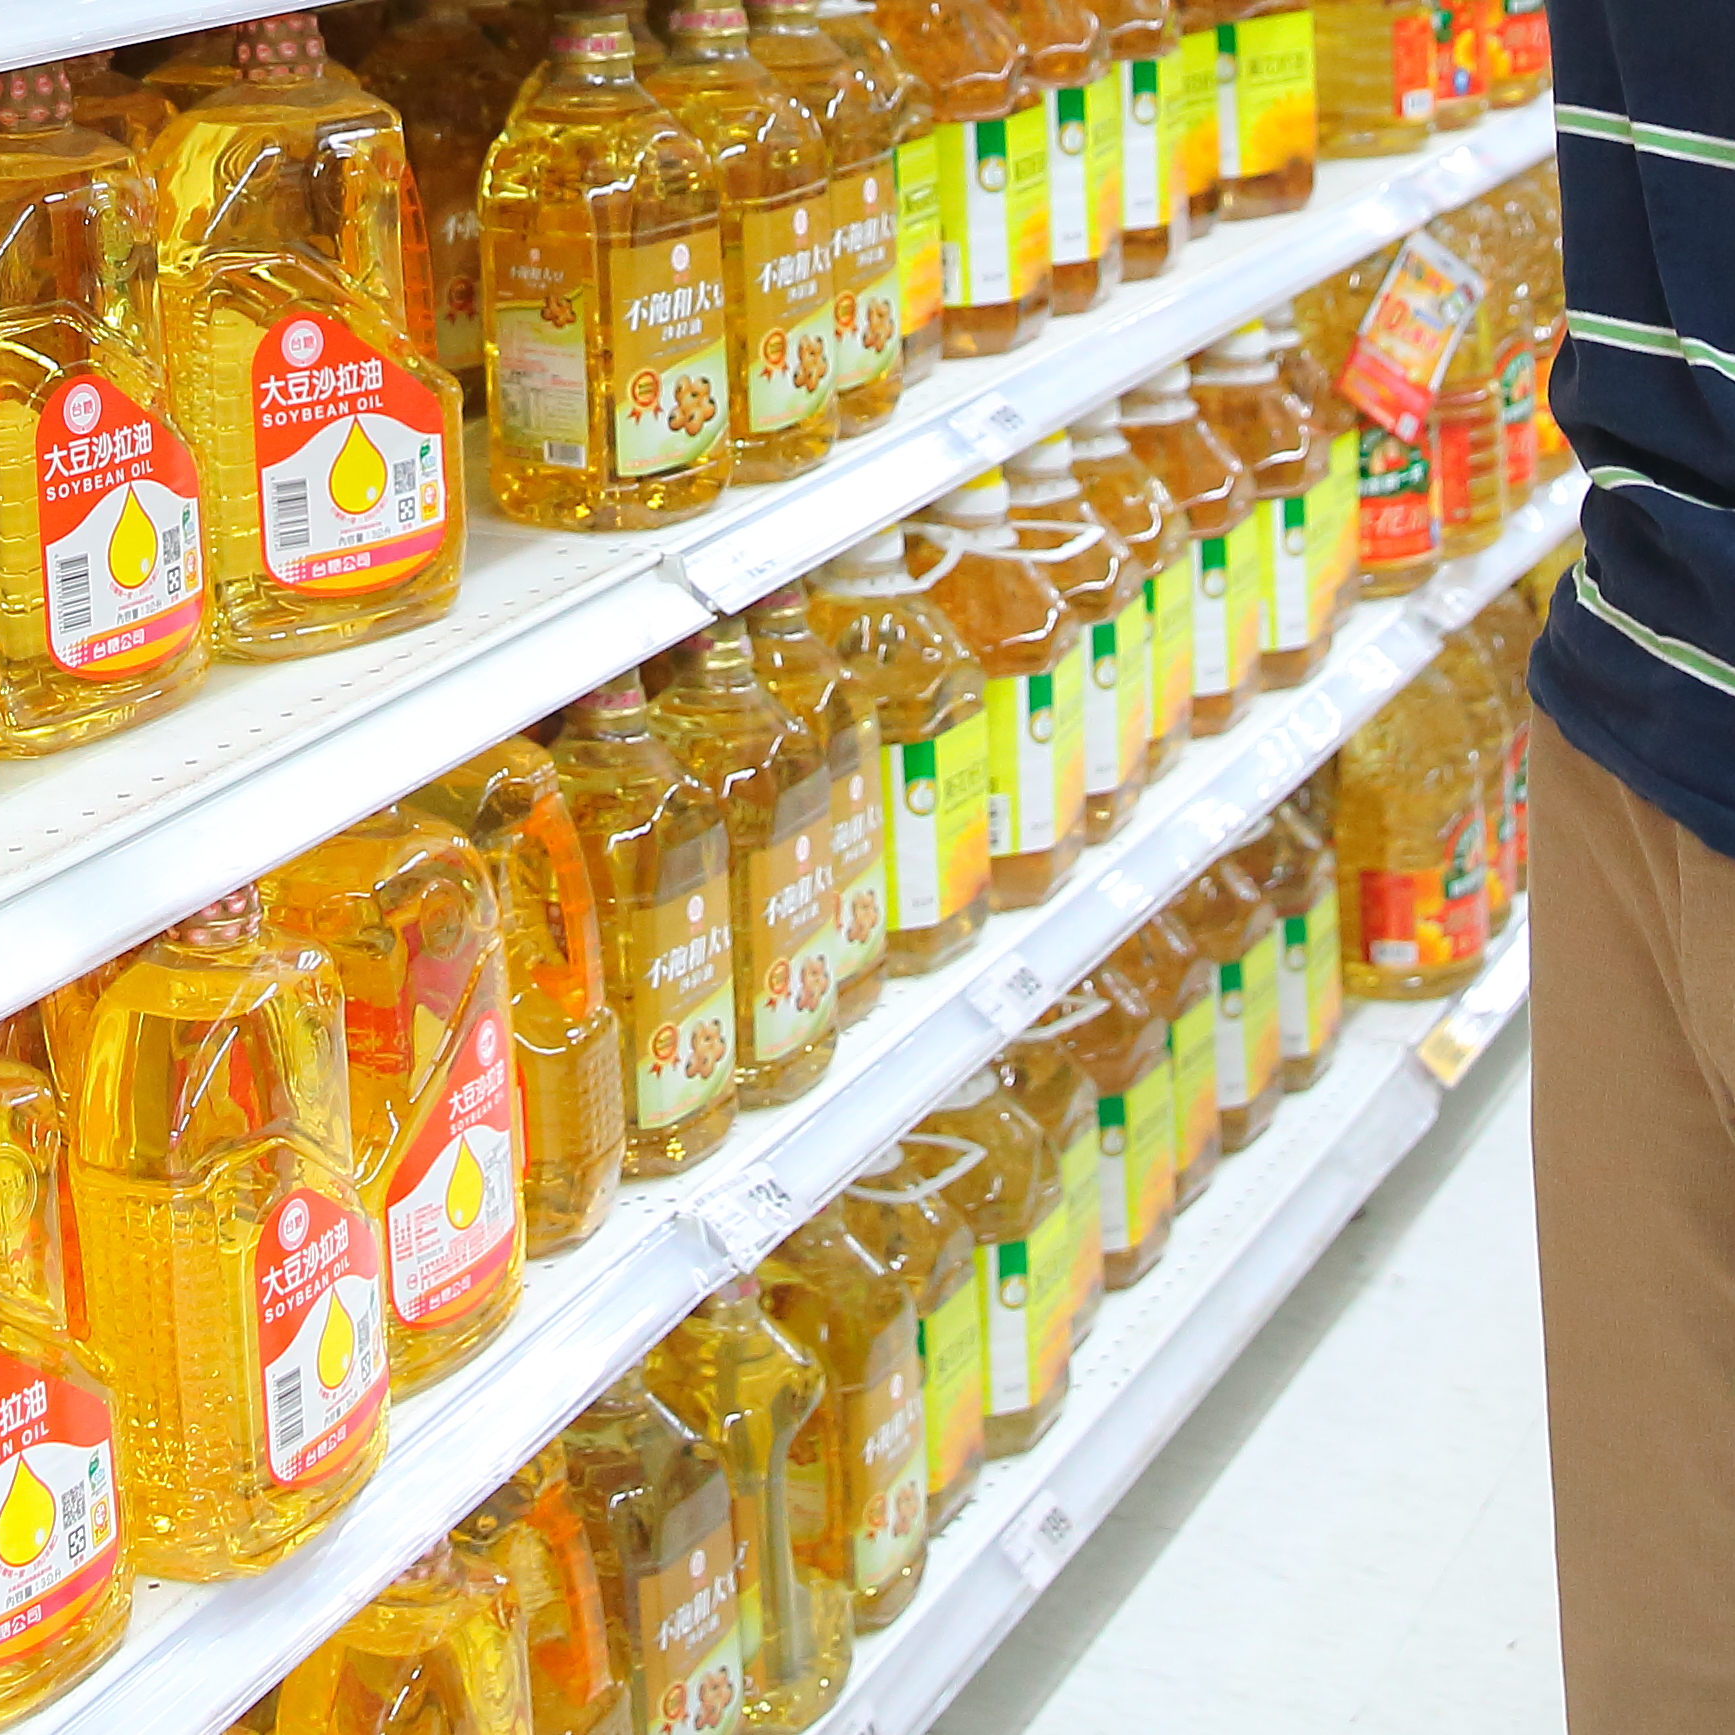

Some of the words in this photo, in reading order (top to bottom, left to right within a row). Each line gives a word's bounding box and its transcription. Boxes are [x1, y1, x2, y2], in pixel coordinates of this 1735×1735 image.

[259, 357, 384, 408] 大豆沙拉油
[262, 402, 348, 430] SOYBEAN
[354, 393, 384, 413] OIL
[42, 419, 153, 483] 大豆沙拉油
[45, 467, 126, 503] SOYBEAN
[129, 458, 155, 480] OIL
[310, 552, 372, 579] 台糖公司
[92, 628, 145, 660] 台糖公司
[447, 1063, 505, 1117] 大豆沙拉油
[449, 1104, 490, 1135] SOYBEAN
[262, 1215, 349, 1304] 大豆沙拉油
[263, 1268, 331, 1324] SOYBEAN
[333, 1253, 351, 1279] OIL
[21, 1421, 51, 1446] OIL
[304, 1422, 348, 1469] 台糖公司
